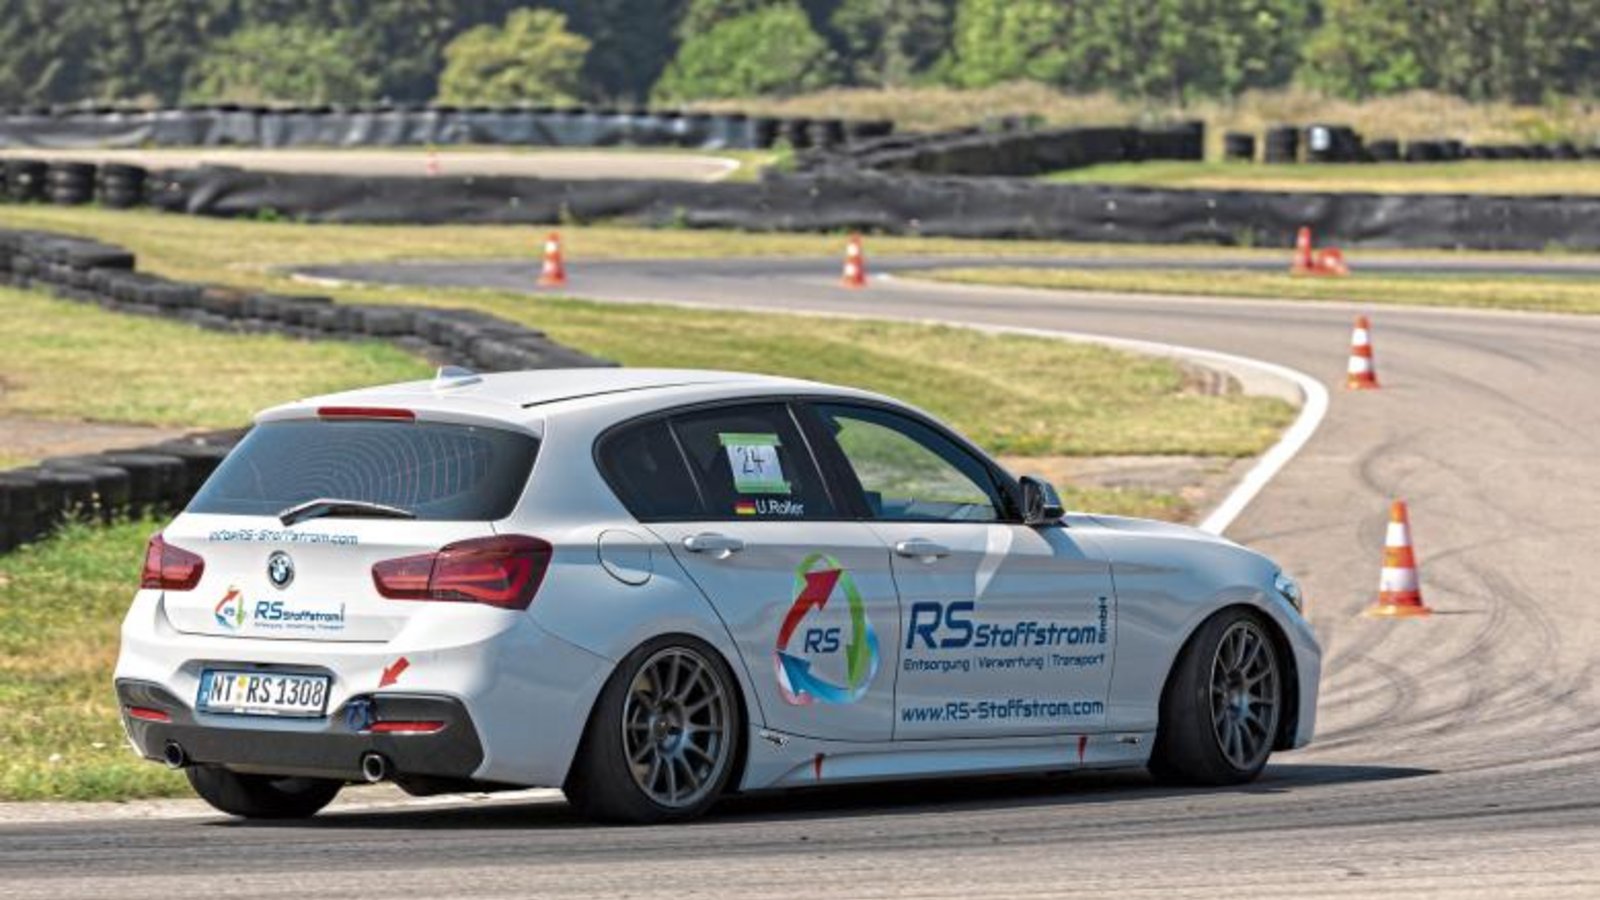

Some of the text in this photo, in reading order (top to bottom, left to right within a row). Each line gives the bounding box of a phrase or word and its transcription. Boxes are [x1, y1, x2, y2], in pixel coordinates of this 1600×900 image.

[736, 446, 765, 474] 24
[255, 600, 284, 621] RS
[905, 600, 1097, 650] RS Stoffstrom
[804, 627, 841, 654] RS
[903, 653, 1106, 673] Entsorgung Verwertung Transport
[210, 674, 236, 702] NT
[246, 676, 273, 703] RS
[274, 678, 324, 707] 1308
[901, 699, 1105, 722] www.RS-Stoffstrom.com
